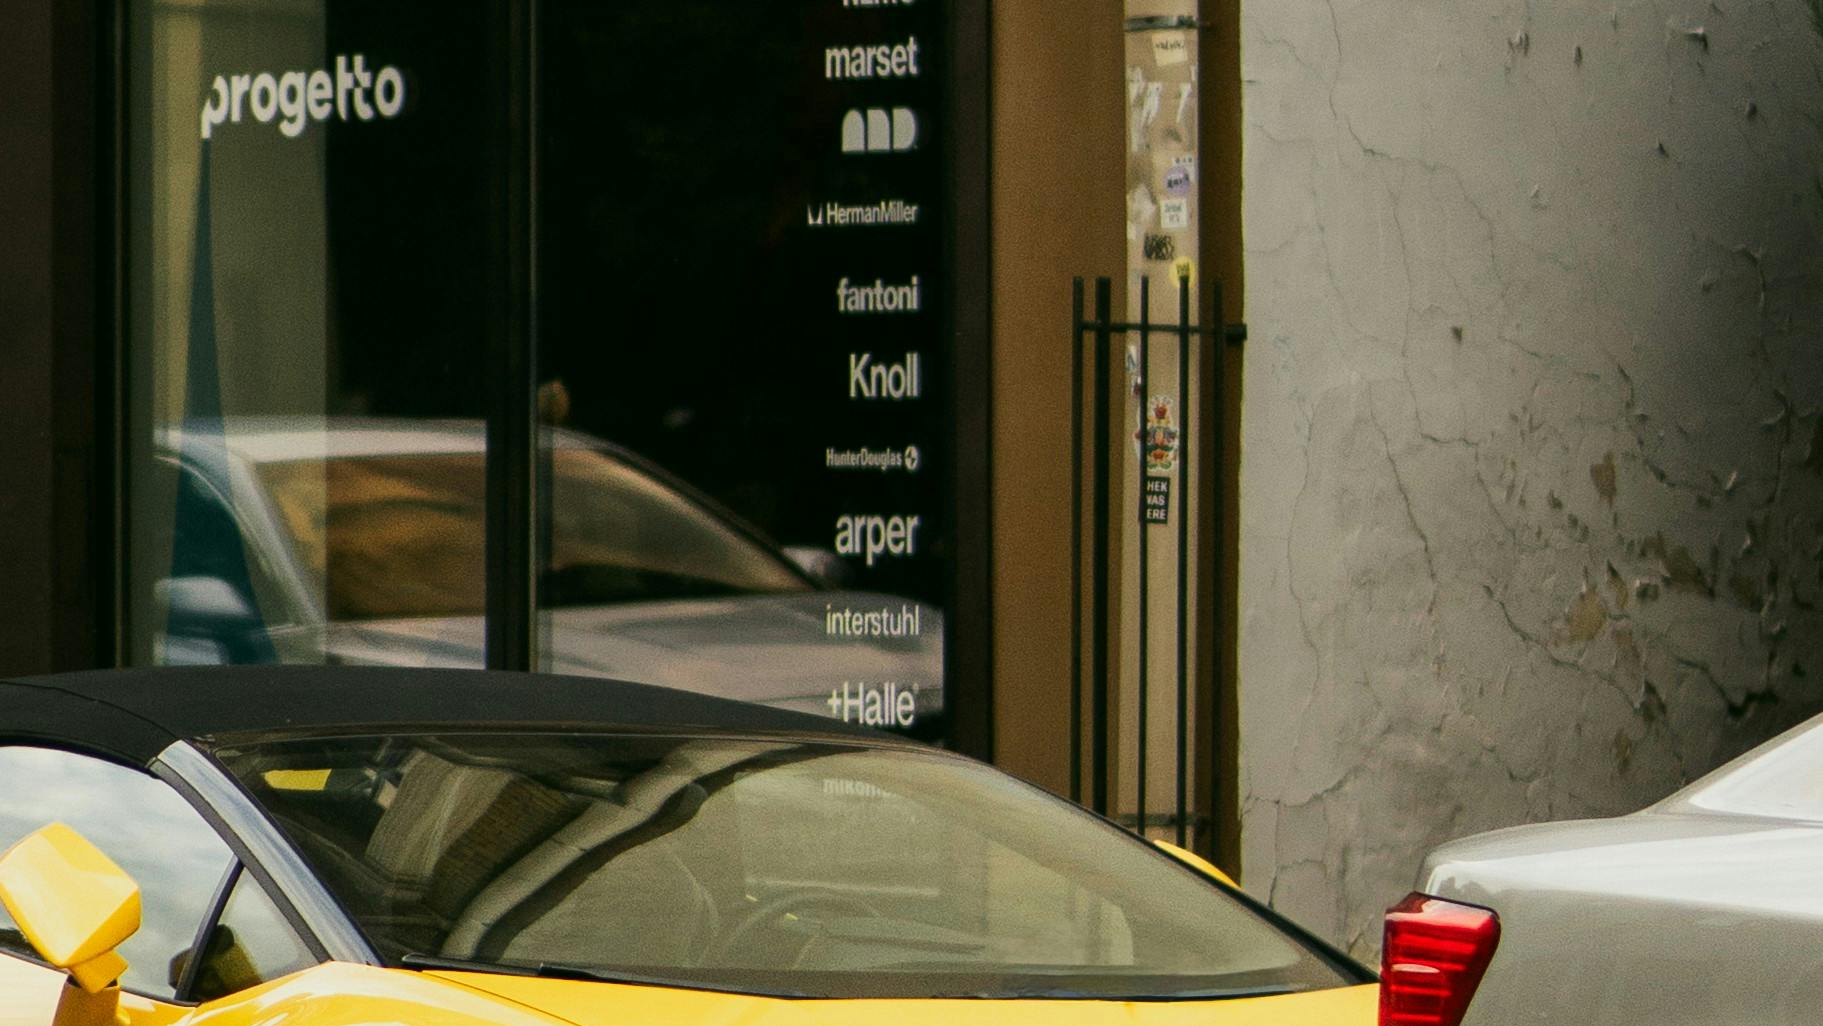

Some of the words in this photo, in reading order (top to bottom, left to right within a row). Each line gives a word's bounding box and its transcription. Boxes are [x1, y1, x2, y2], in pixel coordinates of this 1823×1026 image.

[825, 36, 918, 78] marset
[201, 54, 404, 138] progetto
[826, 202, 918, 225] HermanMiller
[837, 275, 919, 312] fantoni
[849, 352, 920, 399] Knoll
[826, 448, 902, 471] HunterDouglas
[835, 514, 921, 566] arper
[826, 604, 920, 636] interstuhl
